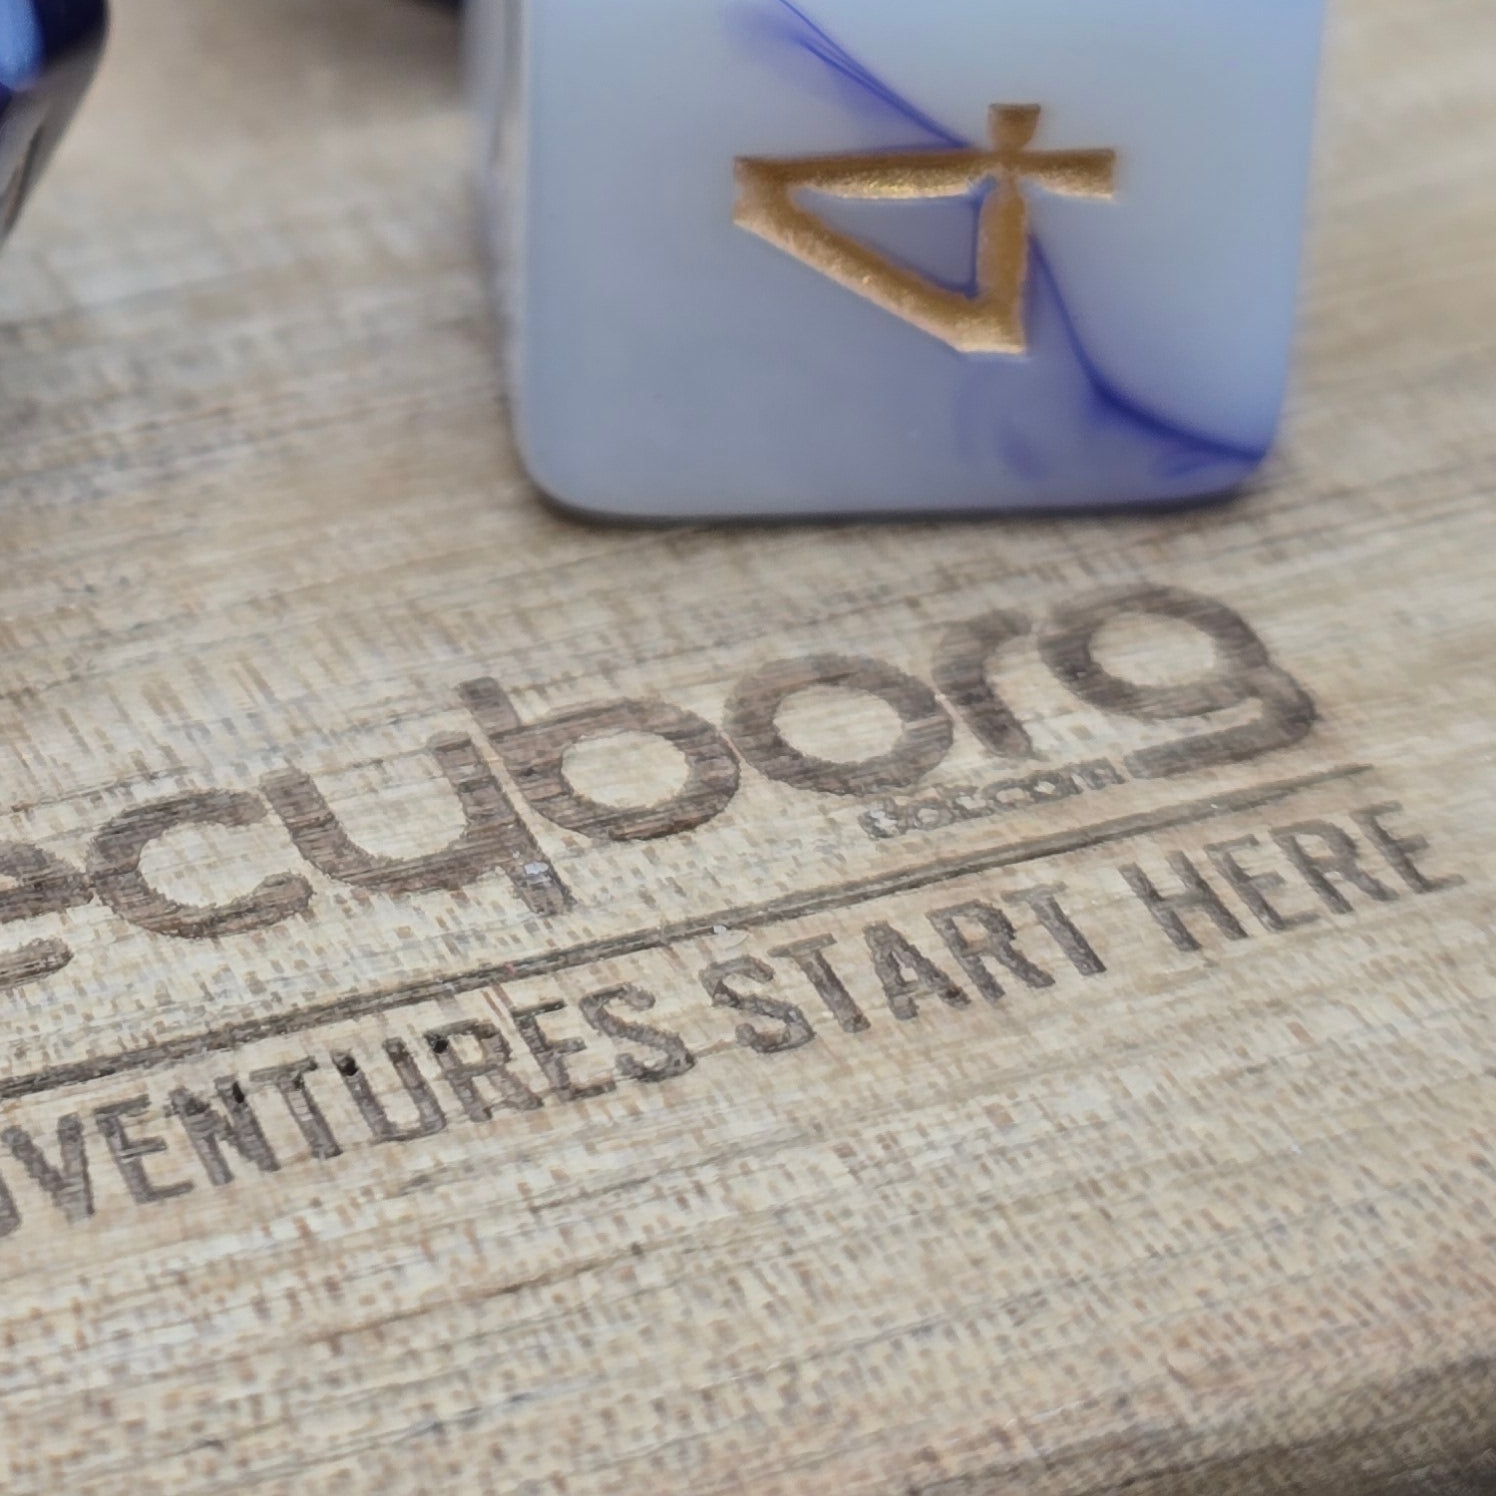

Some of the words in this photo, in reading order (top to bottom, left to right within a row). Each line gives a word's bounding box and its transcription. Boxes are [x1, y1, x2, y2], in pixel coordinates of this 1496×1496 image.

[732, 102, 1118, 356] 4
[700, 879, 1109, 1054] START
[1118, 796, 1464, 954] HERE
